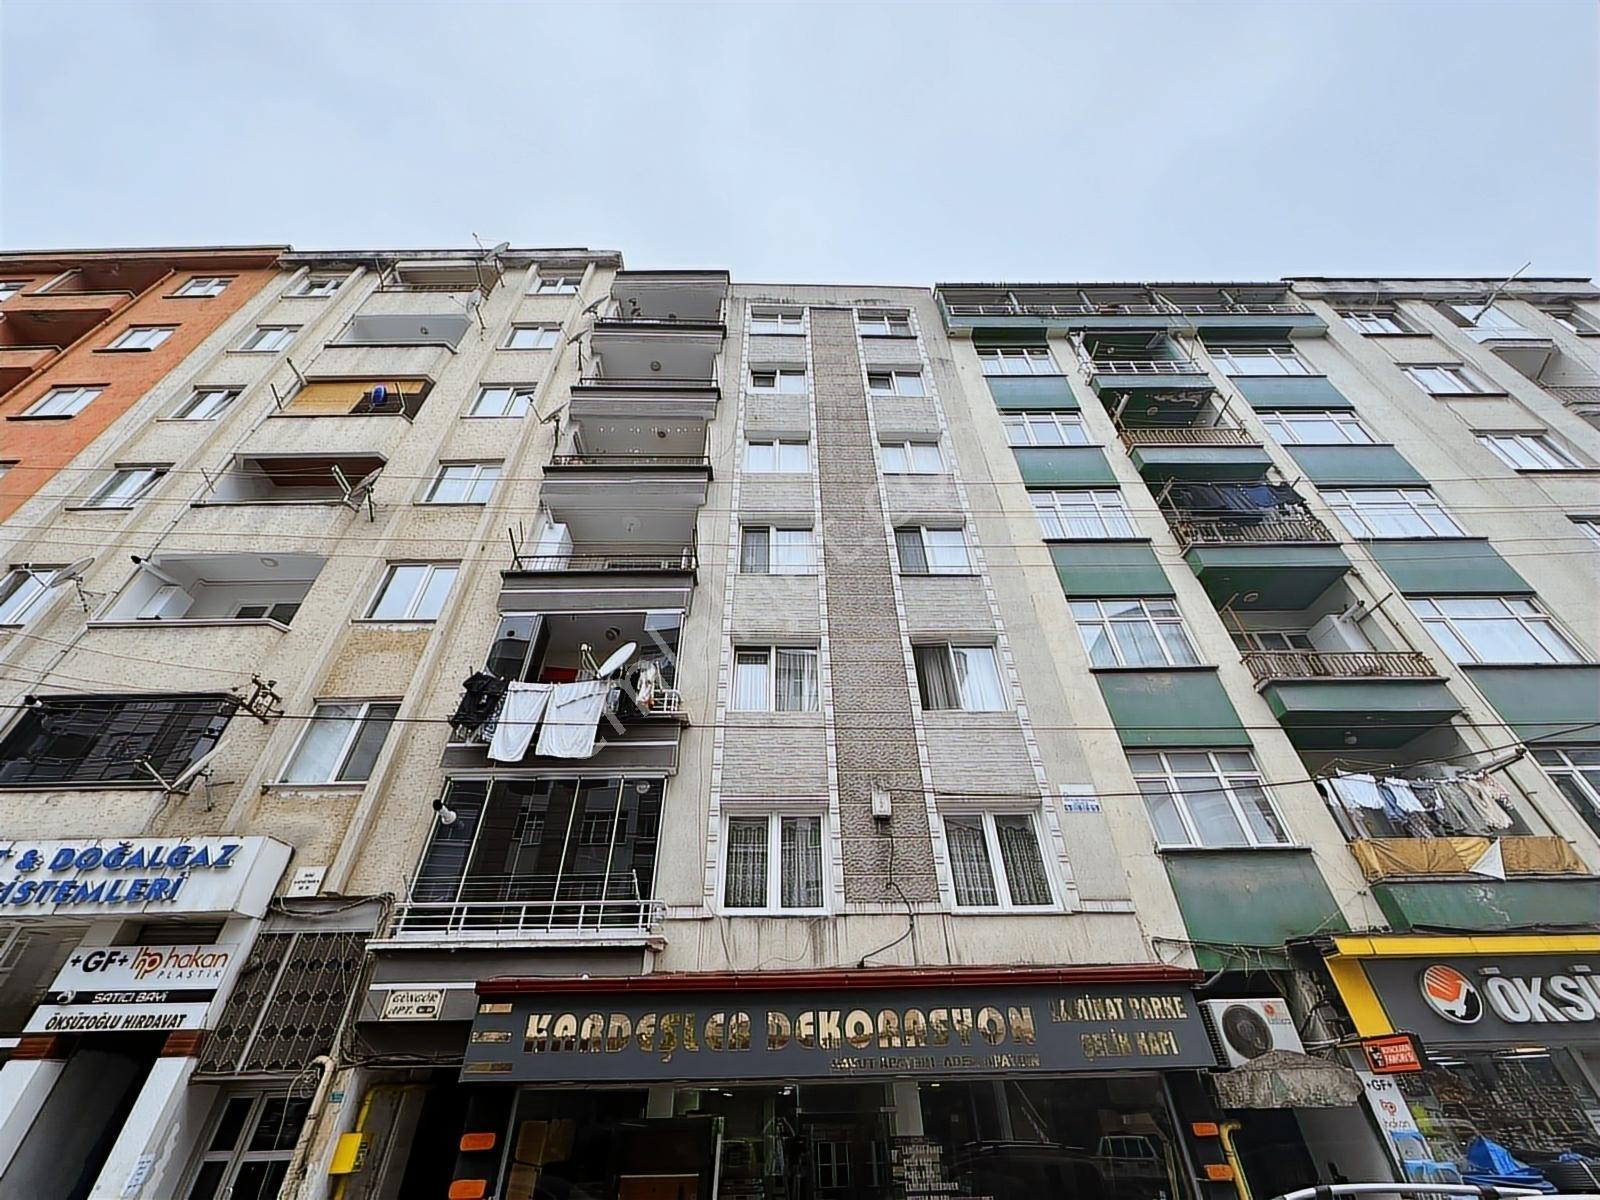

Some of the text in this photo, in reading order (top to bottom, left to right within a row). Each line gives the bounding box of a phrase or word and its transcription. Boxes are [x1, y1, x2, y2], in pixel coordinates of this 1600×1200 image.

[15, 841, 243, 873] & DOĞALGAZ
[0, 872, 190, 905] İSTEMLERİ
[164, 945, 229, 969] hakan
[1127, 995, 1188, 1020] PARKE
[44, 1011, 188, 1031] ÖKSÜZOĞLU HIRDAVAT
[523, 1006, 1037, 1063] KARDEŞLER DEKORASYON
[1134, 1030, 1180, 1056] KAPI
